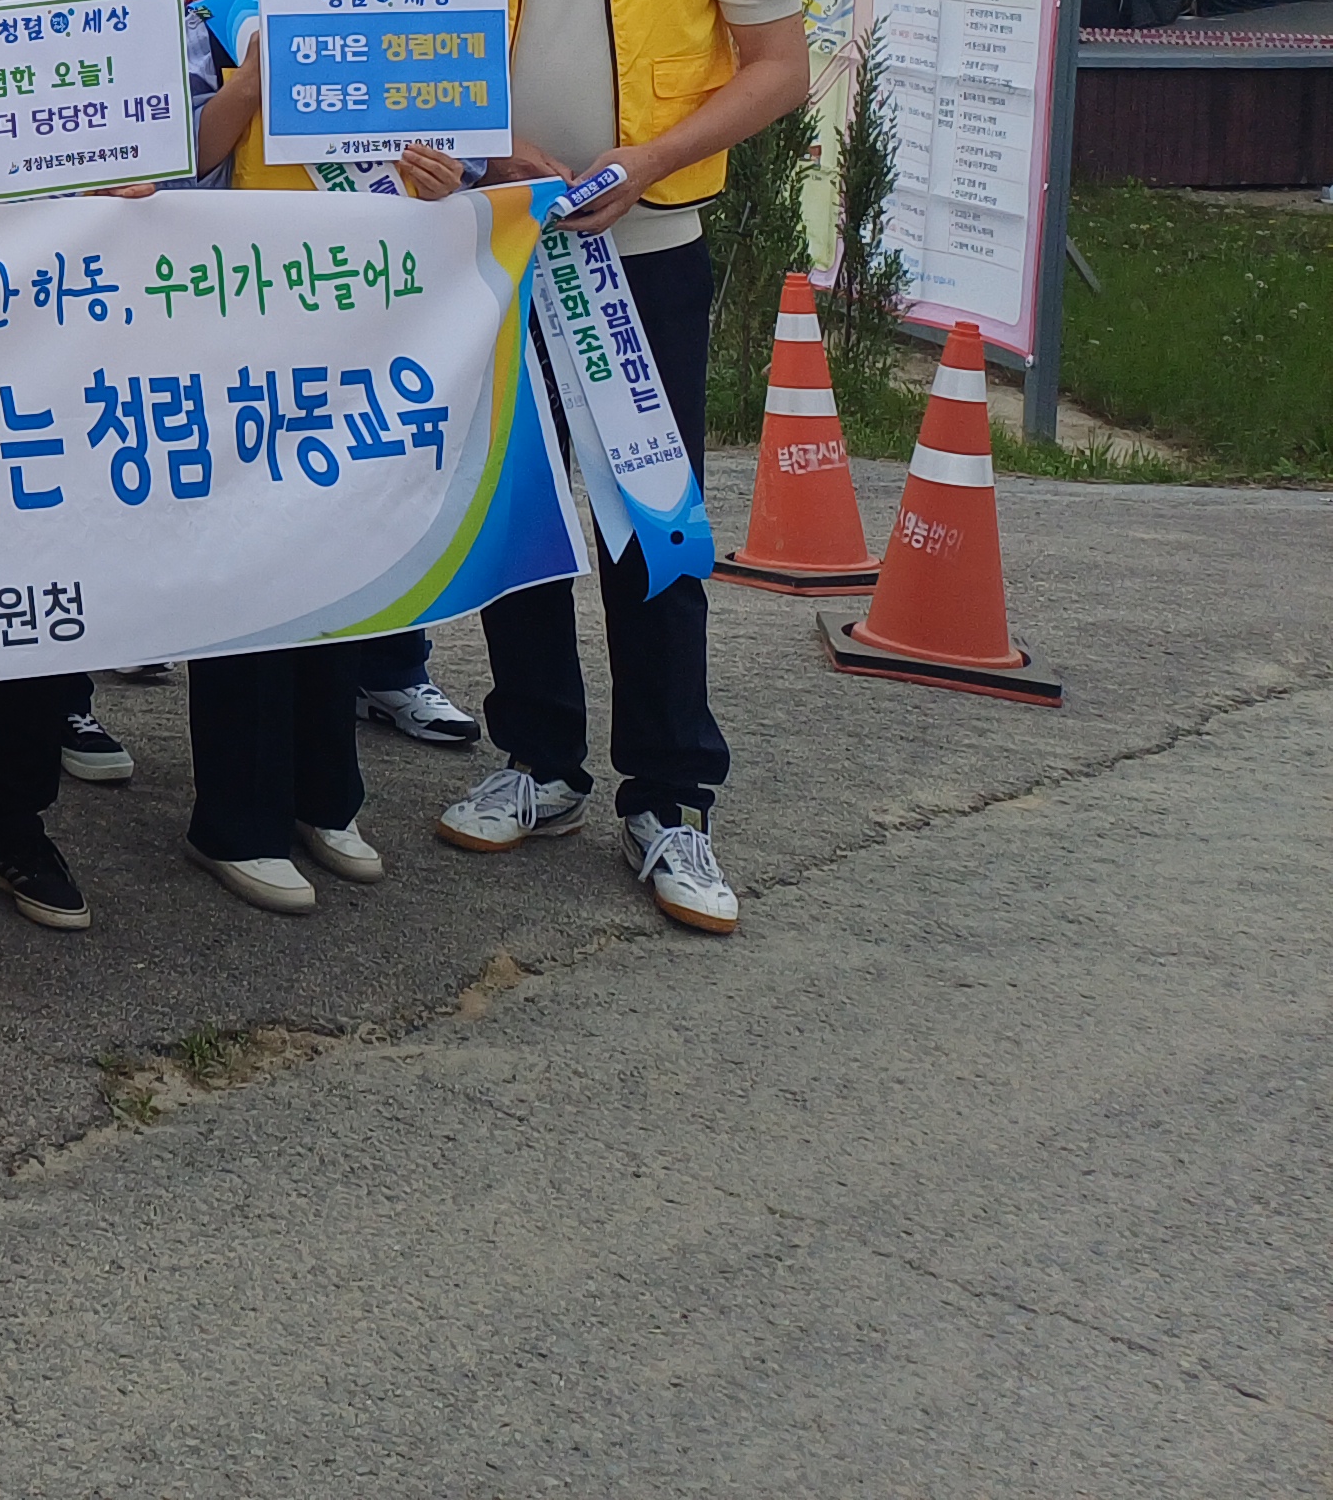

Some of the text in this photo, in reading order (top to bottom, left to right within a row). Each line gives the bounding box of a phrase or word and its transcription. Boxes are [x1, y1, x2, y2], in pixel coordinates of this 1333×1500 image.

[82, 5, 130, 34] 세상
[290, 32, 486, 64] 생각은 청렴하게
[50, 56, 115, 89] 오늘!
[31, 101, 109, 136] 당당한
[123, 93, 171, 124] 내일
[290, 80, 488, 113] 행동은 공정하게
[22, 144, 139, 172] 경상남도하동교육지원청
[31, 251, 134, 328] 하동,
[144, 243, 274, 320] 우리가
[279, 239, 426, 313] 만들어요
[550, 263, 592, 322] 문화
[572, 324, 614, 384] 조성
[599, 298, 663, 415] 함께하는
[83, 364, 213, 507] 청렴
[226, 354, 451, 489] 하동교육
